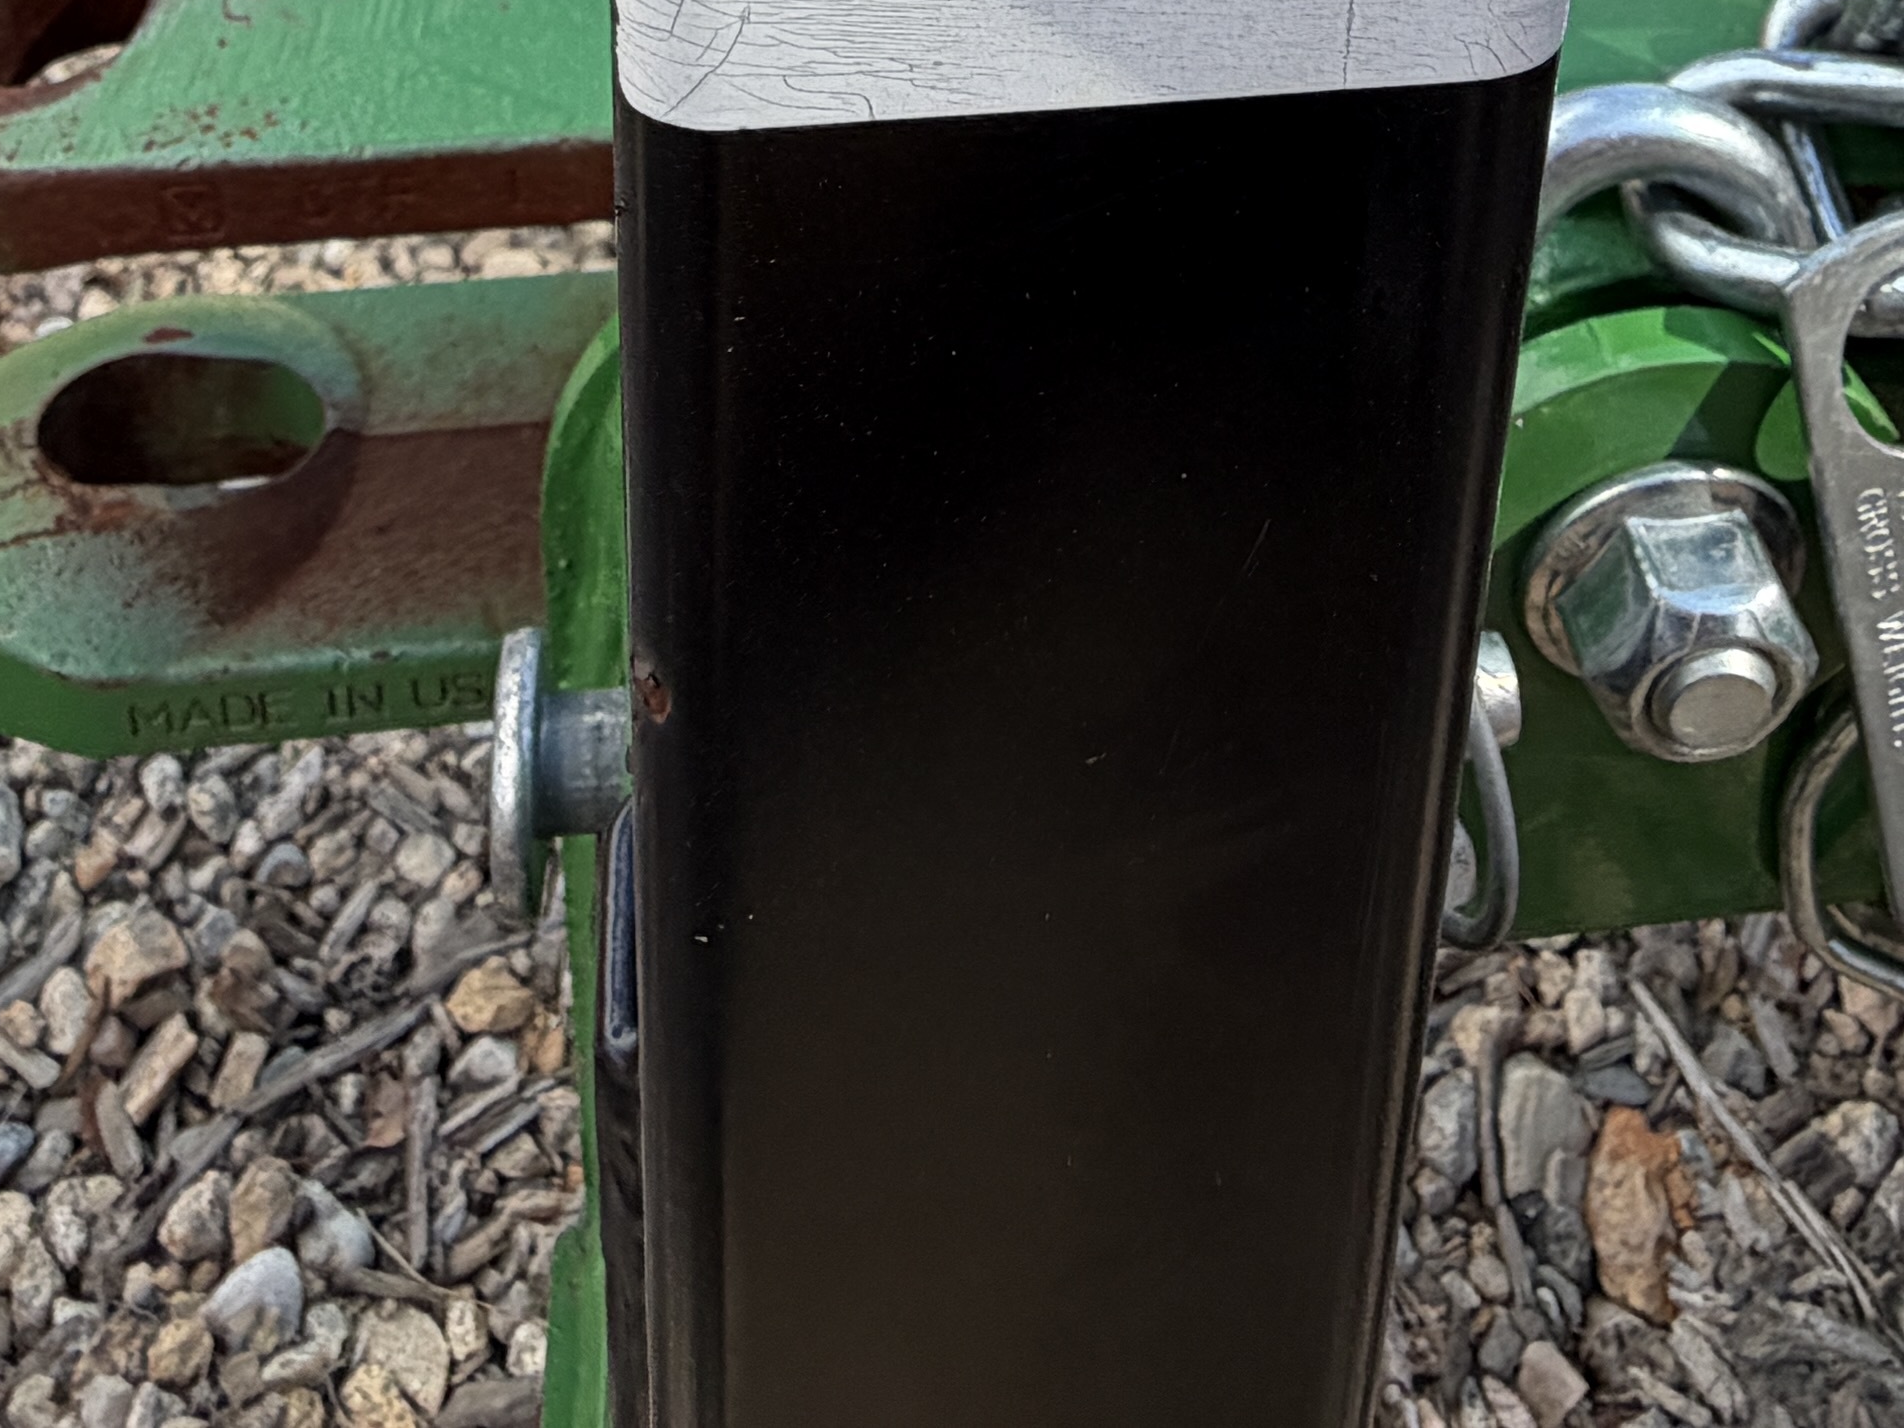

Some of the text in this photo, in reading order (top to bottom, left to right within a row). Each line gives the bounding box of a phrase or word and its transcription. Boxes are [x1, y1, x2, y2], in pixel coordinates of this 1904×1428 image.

[1857, 488, 1900, 599] GROSS
[128, 671, 496, 737] MADE IN US
